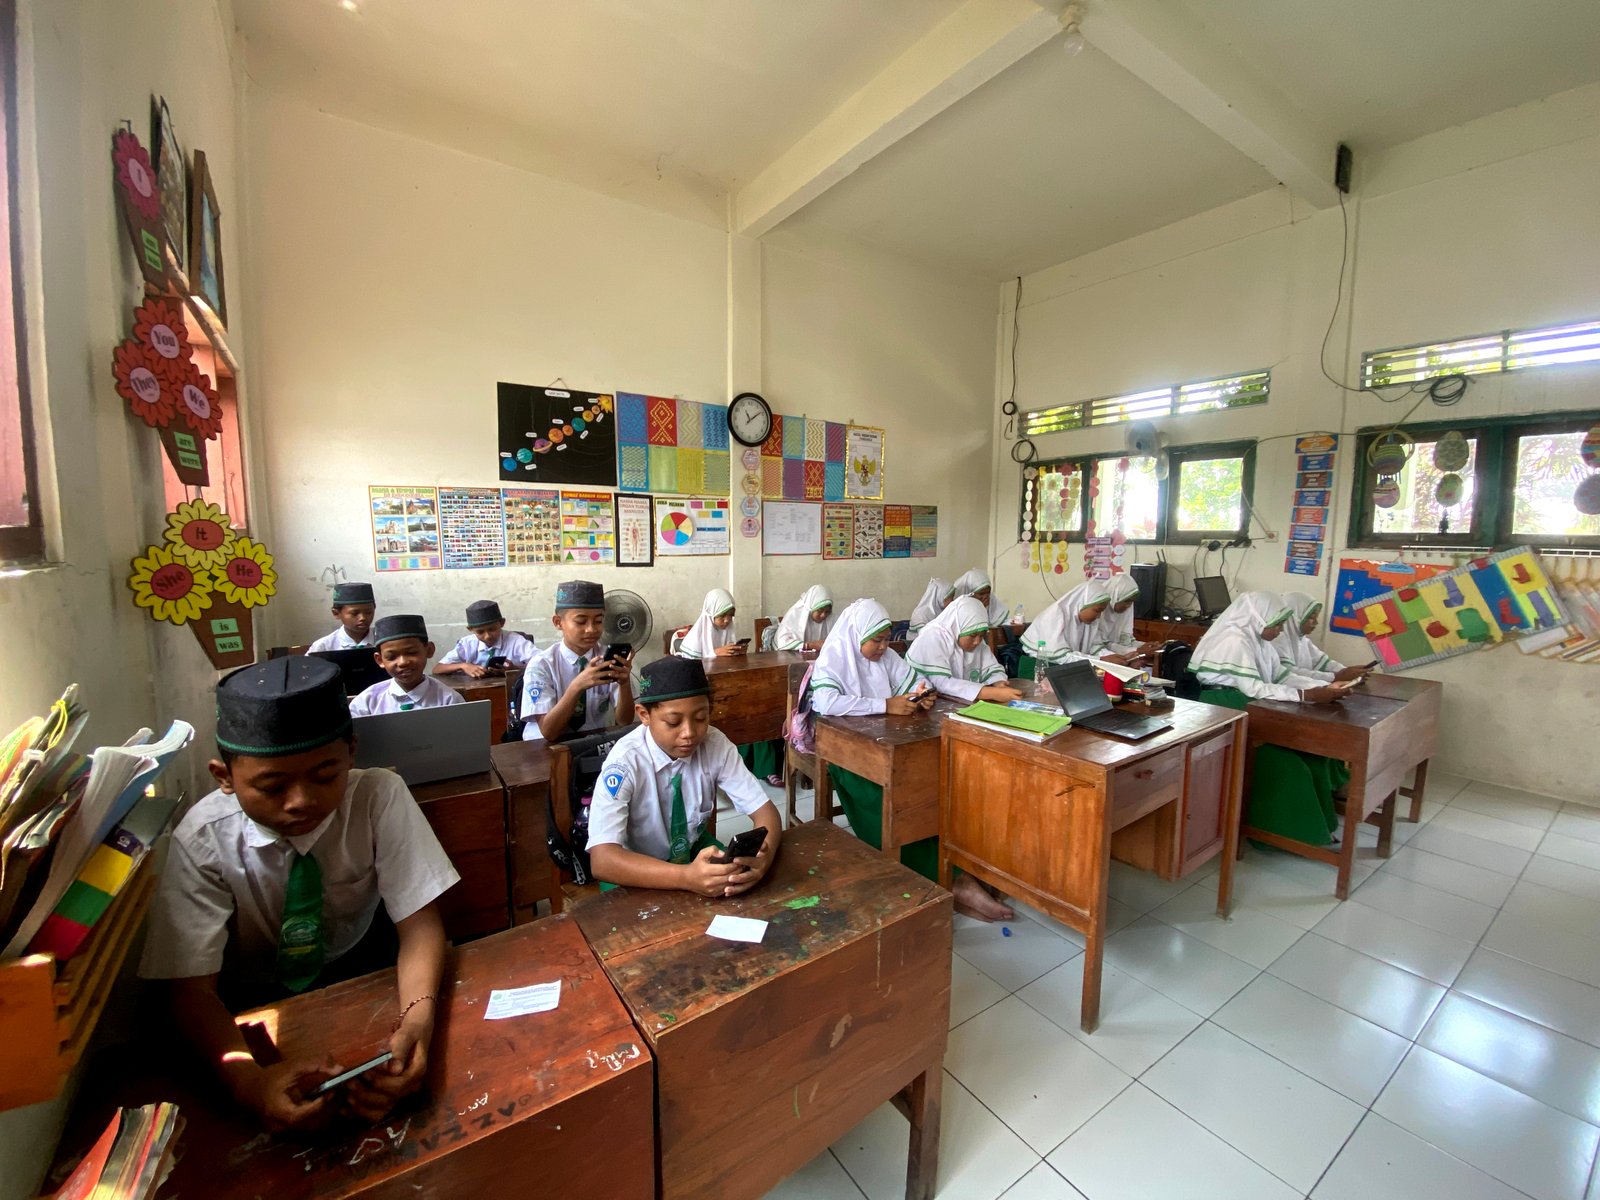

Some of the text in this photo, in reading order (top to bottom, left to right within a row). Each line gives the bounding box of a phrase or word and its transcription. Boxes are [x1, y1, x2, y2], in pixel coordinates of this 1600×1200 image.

[153, 330, 176, 347] You
[132, 376, 157, 393] They
[196, 527, 208, 541] It
[235, 564, 254, 577] He
[155, 569, 187, 592] She
[219, 622, 230, 632] is
[218, 640, 240, 651] was
